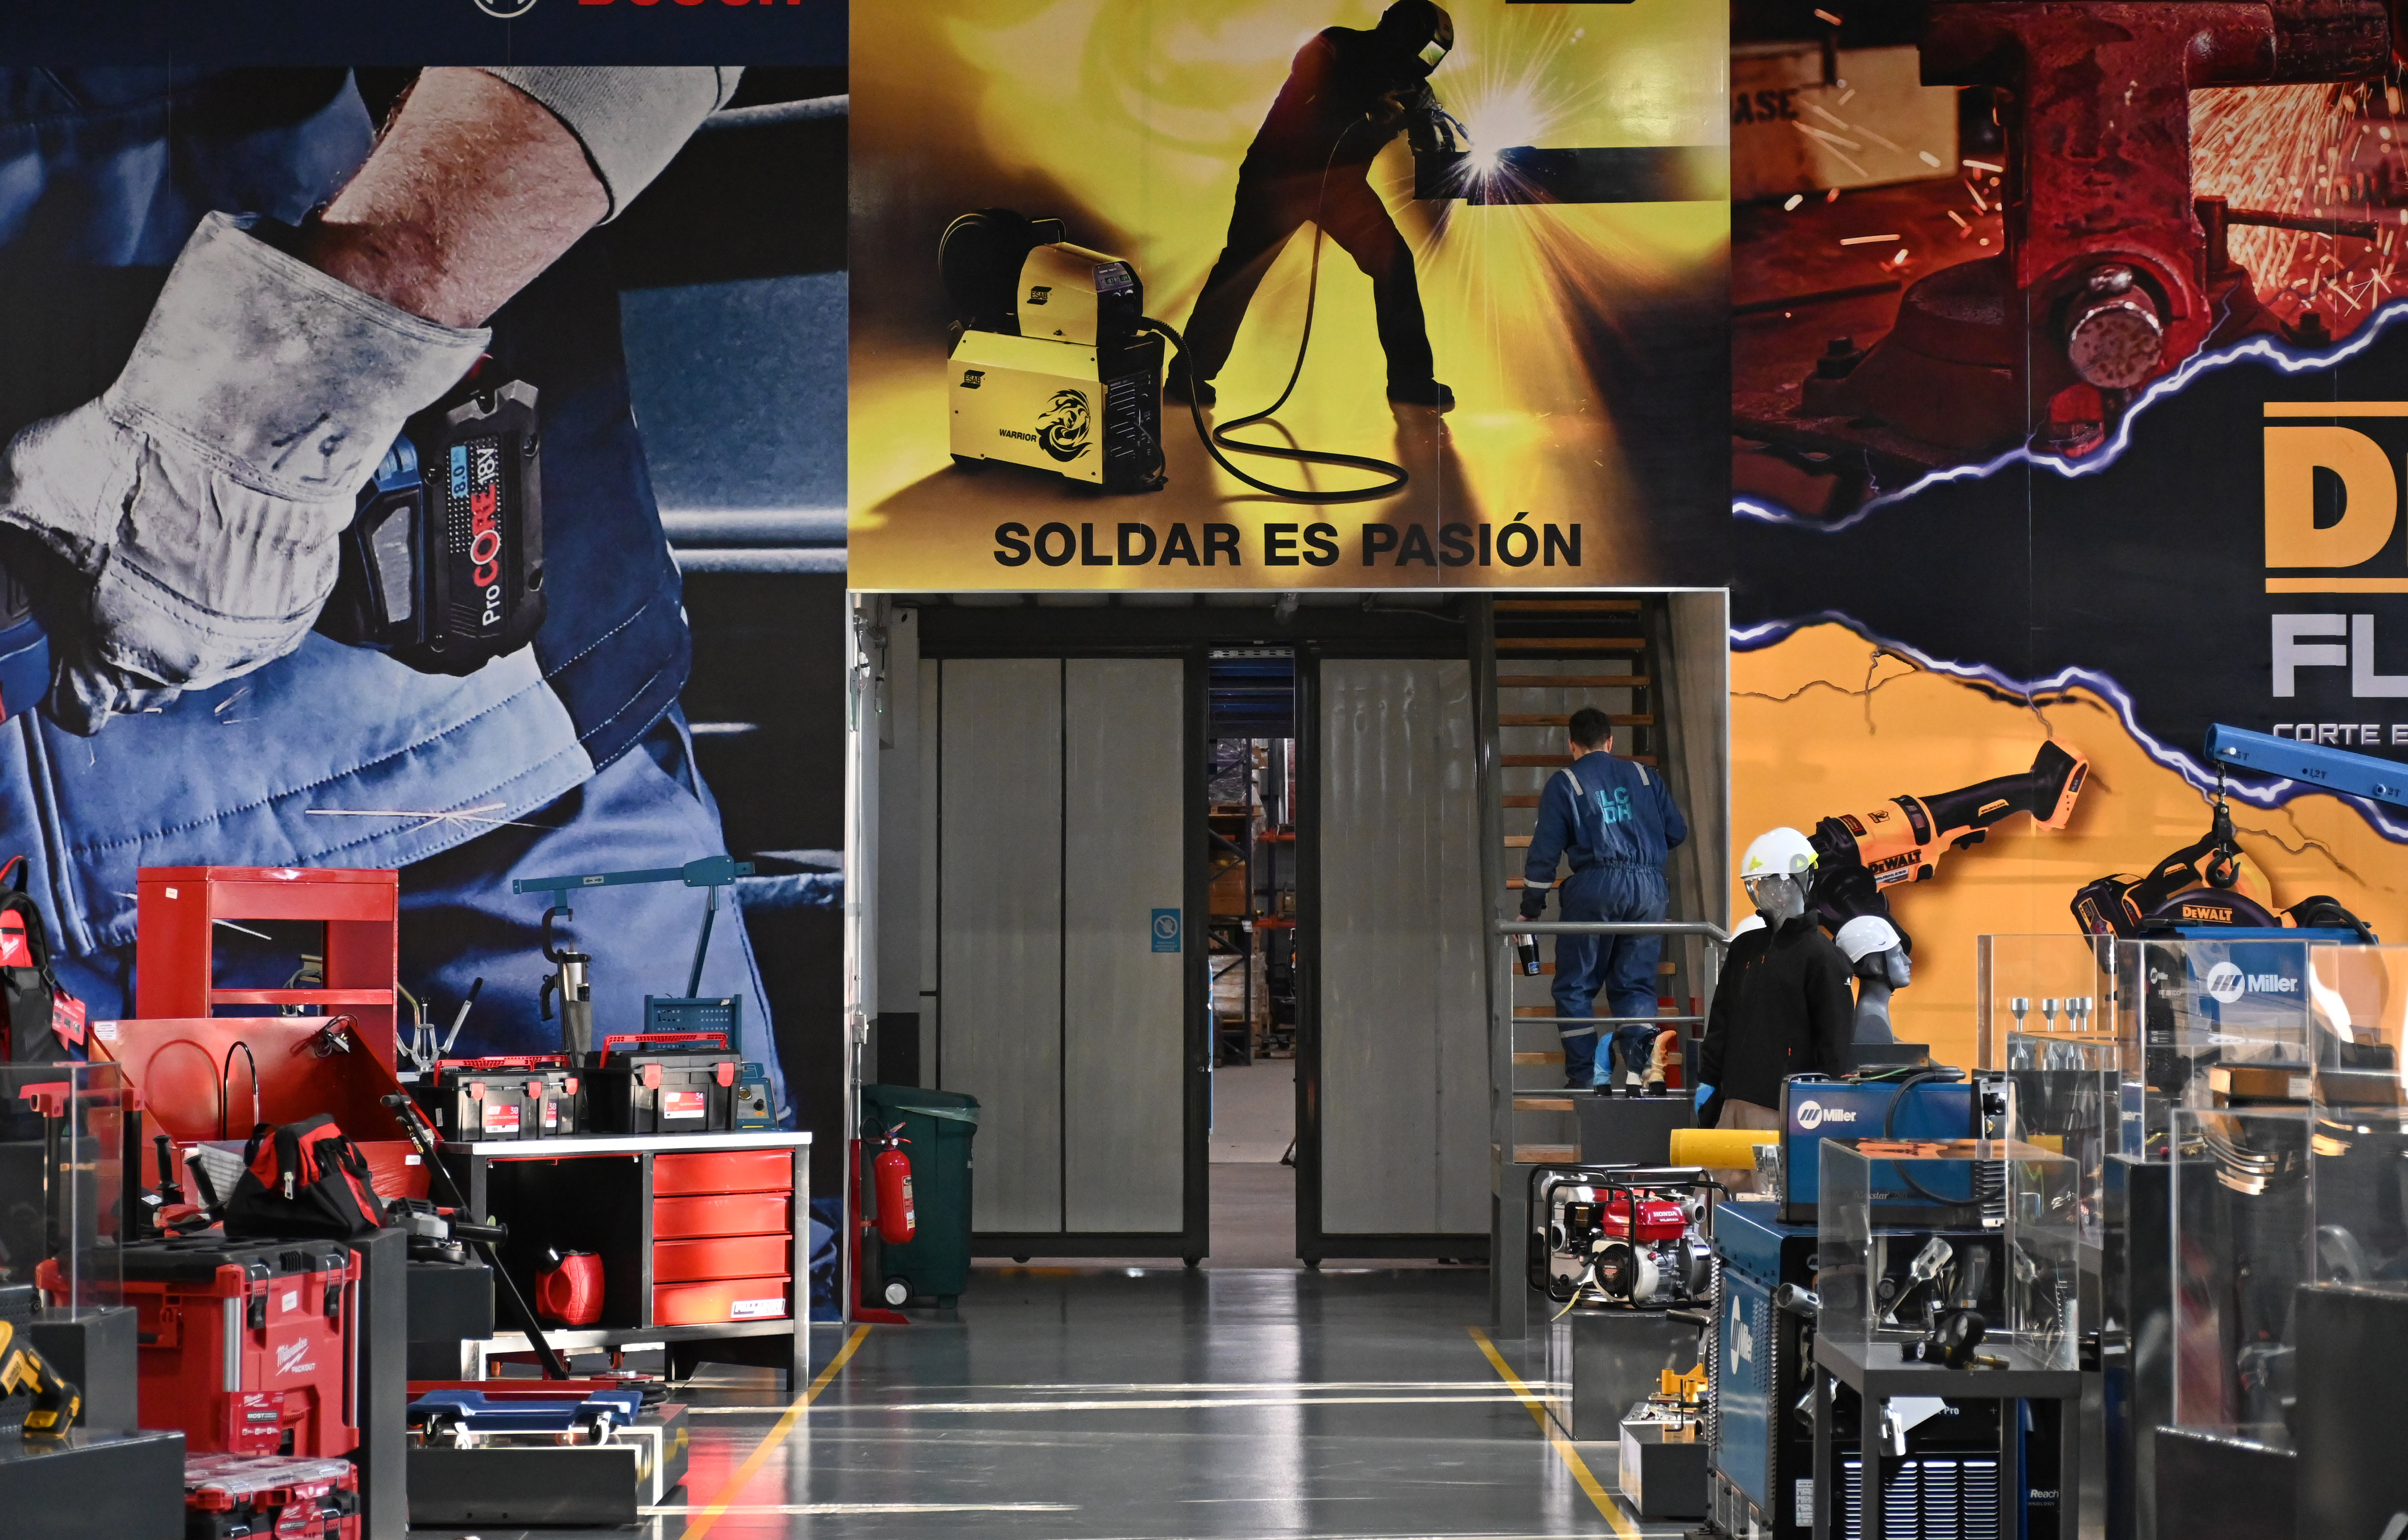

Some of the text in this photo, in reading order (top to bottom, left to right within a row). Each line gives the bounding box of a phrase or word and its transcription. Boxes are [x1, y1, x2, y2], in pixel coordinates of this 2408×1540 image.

[1031, 291, 1048, 300] ESAB
[964, 375, 981, 384] ESAB
[999, 429, 1037, 442] WARRIOR
[453, 465, 466, 494] 8.0
[2263, 426, 2408, 568] D
[994, 511, 1581, 567] SOLDAR ES PASIÓN
[2273, 723, 2381, 745] CORTE
[1600, 787, 1629, 807] LC
[2388, 787, 2401, 798] 2T
[1604, 803, 1633, 824] DH
[2248, 974, 2298, 992] Miller
[1824, 1108, 1857, 1122] Miller
[1854, 1190, 1890, 1200] Mstar
[1740, 1322, 1754, 1363] Miller
[276, 1337, 308, 1368] Milwaukee
[291, 1363, 316, 1373] PACKOUT
[1944, 1406, 1960, 1415] Pro
